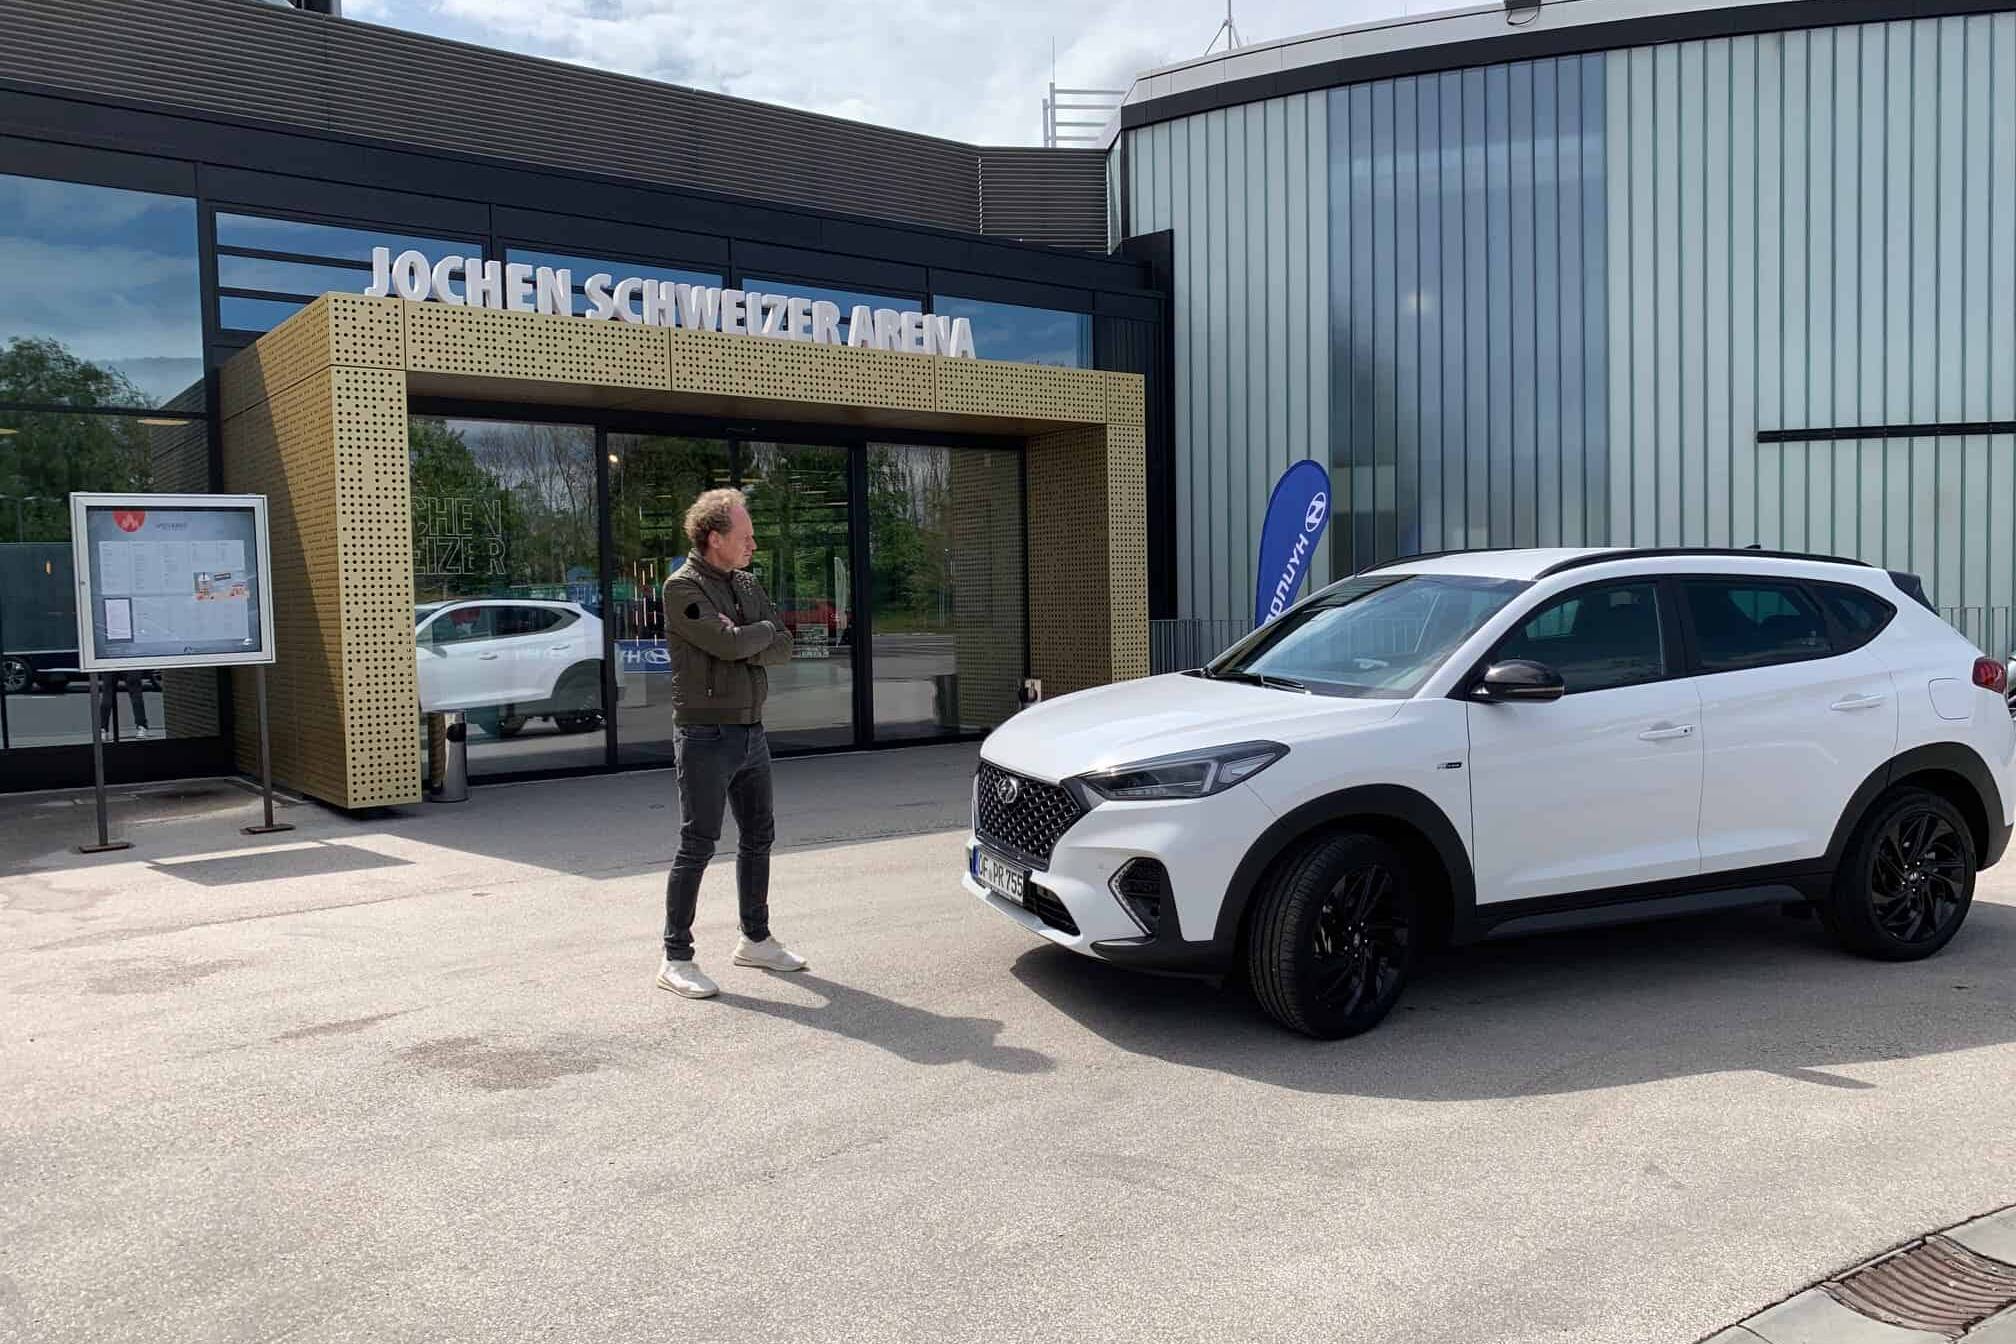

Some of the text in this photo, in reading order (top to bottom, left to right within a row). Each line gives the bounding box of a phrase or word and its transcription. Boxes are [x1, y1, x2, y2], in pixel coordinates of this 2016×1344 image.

[365, 246, 977, 359] JOCHEN SCHWEIZER ARENA
[411, 495, 502, 537] CHEN
[412, 536, 506, 575] EIZER
